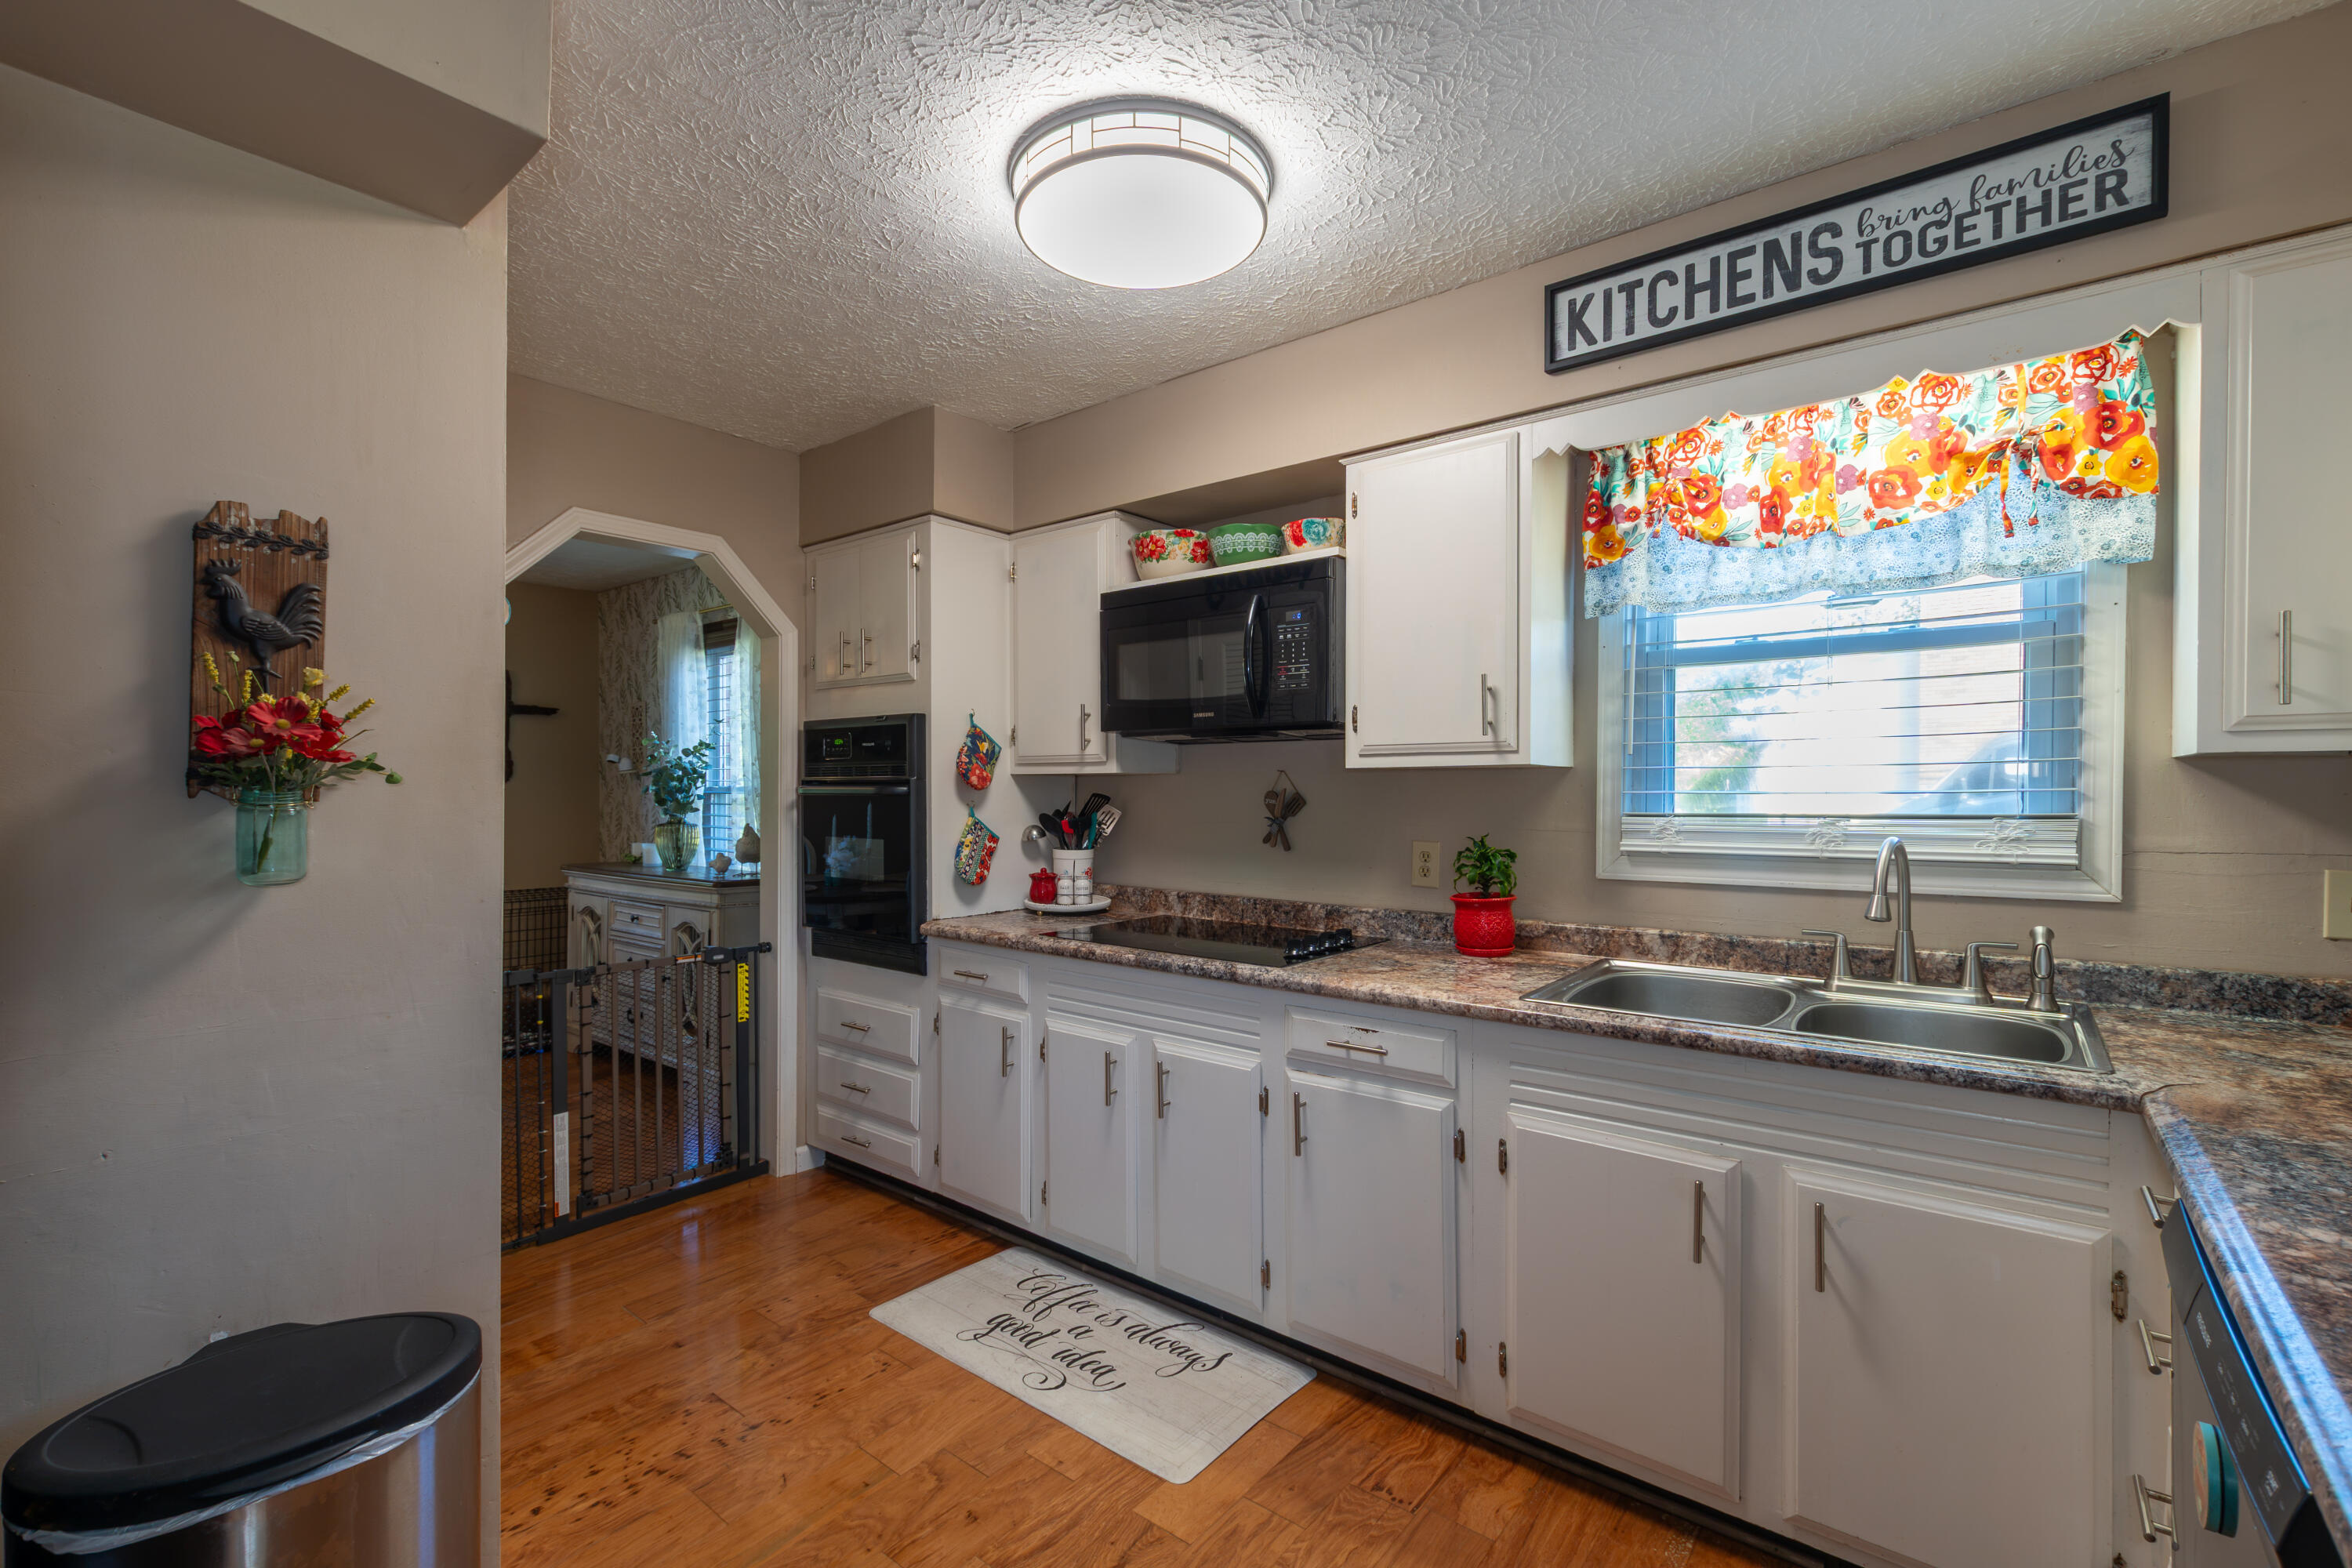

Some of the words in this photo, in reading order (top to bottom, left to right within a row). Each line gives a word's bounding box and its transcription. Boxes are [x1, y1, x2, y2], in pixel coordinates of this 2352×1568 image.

[1857, 197, 1960, 238] bring
[1969, 139, 2136, 212] families
[1567, 221, 1845, 352] KITCHENS
[1855, 168, 2130, 275] TOGETHER
[1004, 1268, 1099, 1322] Coffee
[1094, 1312, 1129, 1327] is
[1116, 1308, 1233, 1377] always
[1051, 1341, 1134, 1392] idea
[1067, 1325, 1095, 1340] a
